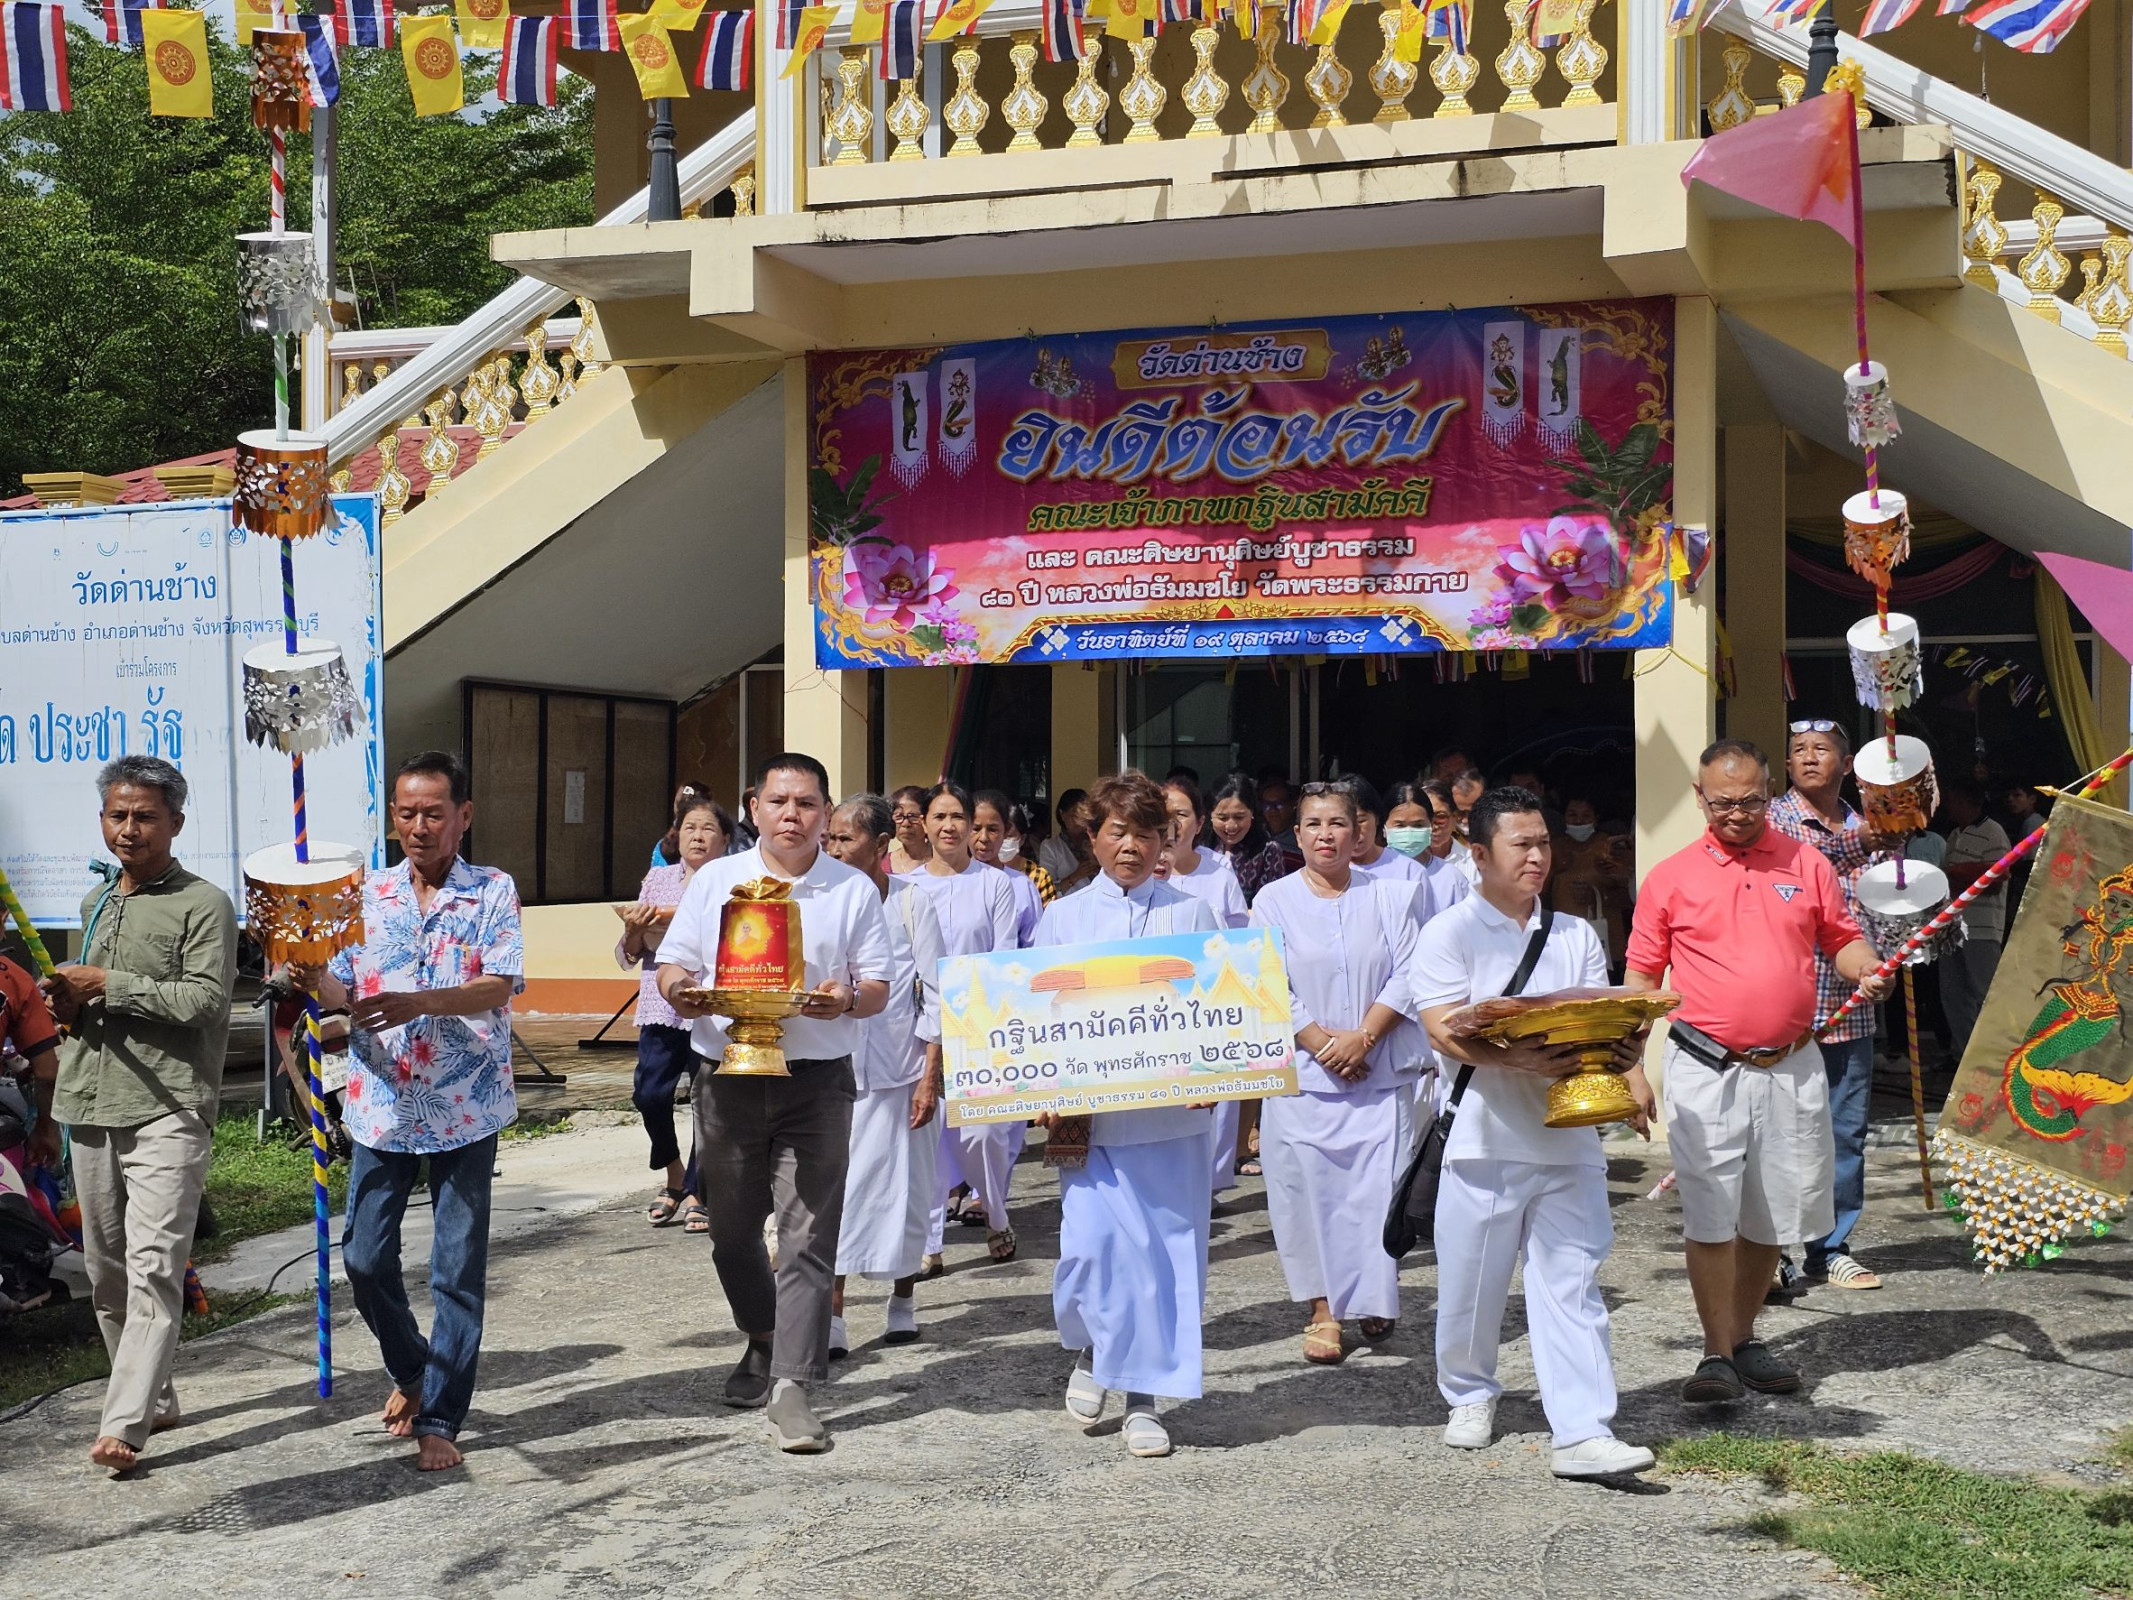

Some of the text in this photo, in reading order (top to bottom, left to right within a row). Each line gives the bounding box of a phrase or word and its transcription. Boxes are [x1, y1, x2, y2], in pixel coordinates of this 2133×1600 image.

[1141, 338, 1304, 377] วัดด่านช้าง
[1000, 382, 1461, 480] ยินดีต้อนรับ
[1028, 478, 1430, 530] คณะเจ้าภาพกฐินสามัคคี
[1027, 534, 1414, 570] และ คณะศิษยานุศิษย์บูชาธรรม
[72, 562, 217, 606] วัดด่านช้าง
[981, 571, 1468, 606] ๘๑ ปี หลวงพ่อธัมมชโย วัดพระธรรมกาย
[84, 617, 184, 641] อำเภอด่านช้าง
[192, 612, 319, 639] จังหวัดสุพรรบุรี
[1076, 624, 1369, 652] วันอาทิตย์ที่ ๑๙ ตุลาคม ๒๕๖๘
[116, 656, 178, 678] เข้าร่วมโครงการ
[30, 702, 127, 763] ประชา
[989, 996, 1244, 1054] กฐินสามัคคีทั่วไทย
[956, 1038, 1284, 1087] ๓๐,๐๐๐ วัด พุทธศักราช ๒๕๖๘
[961, 1076, 1284, 1118] โดย คณะศิษยานุศิษย์ บูชาธรรม ๘๑ ปี หลวงพ่อธัมมชโย
